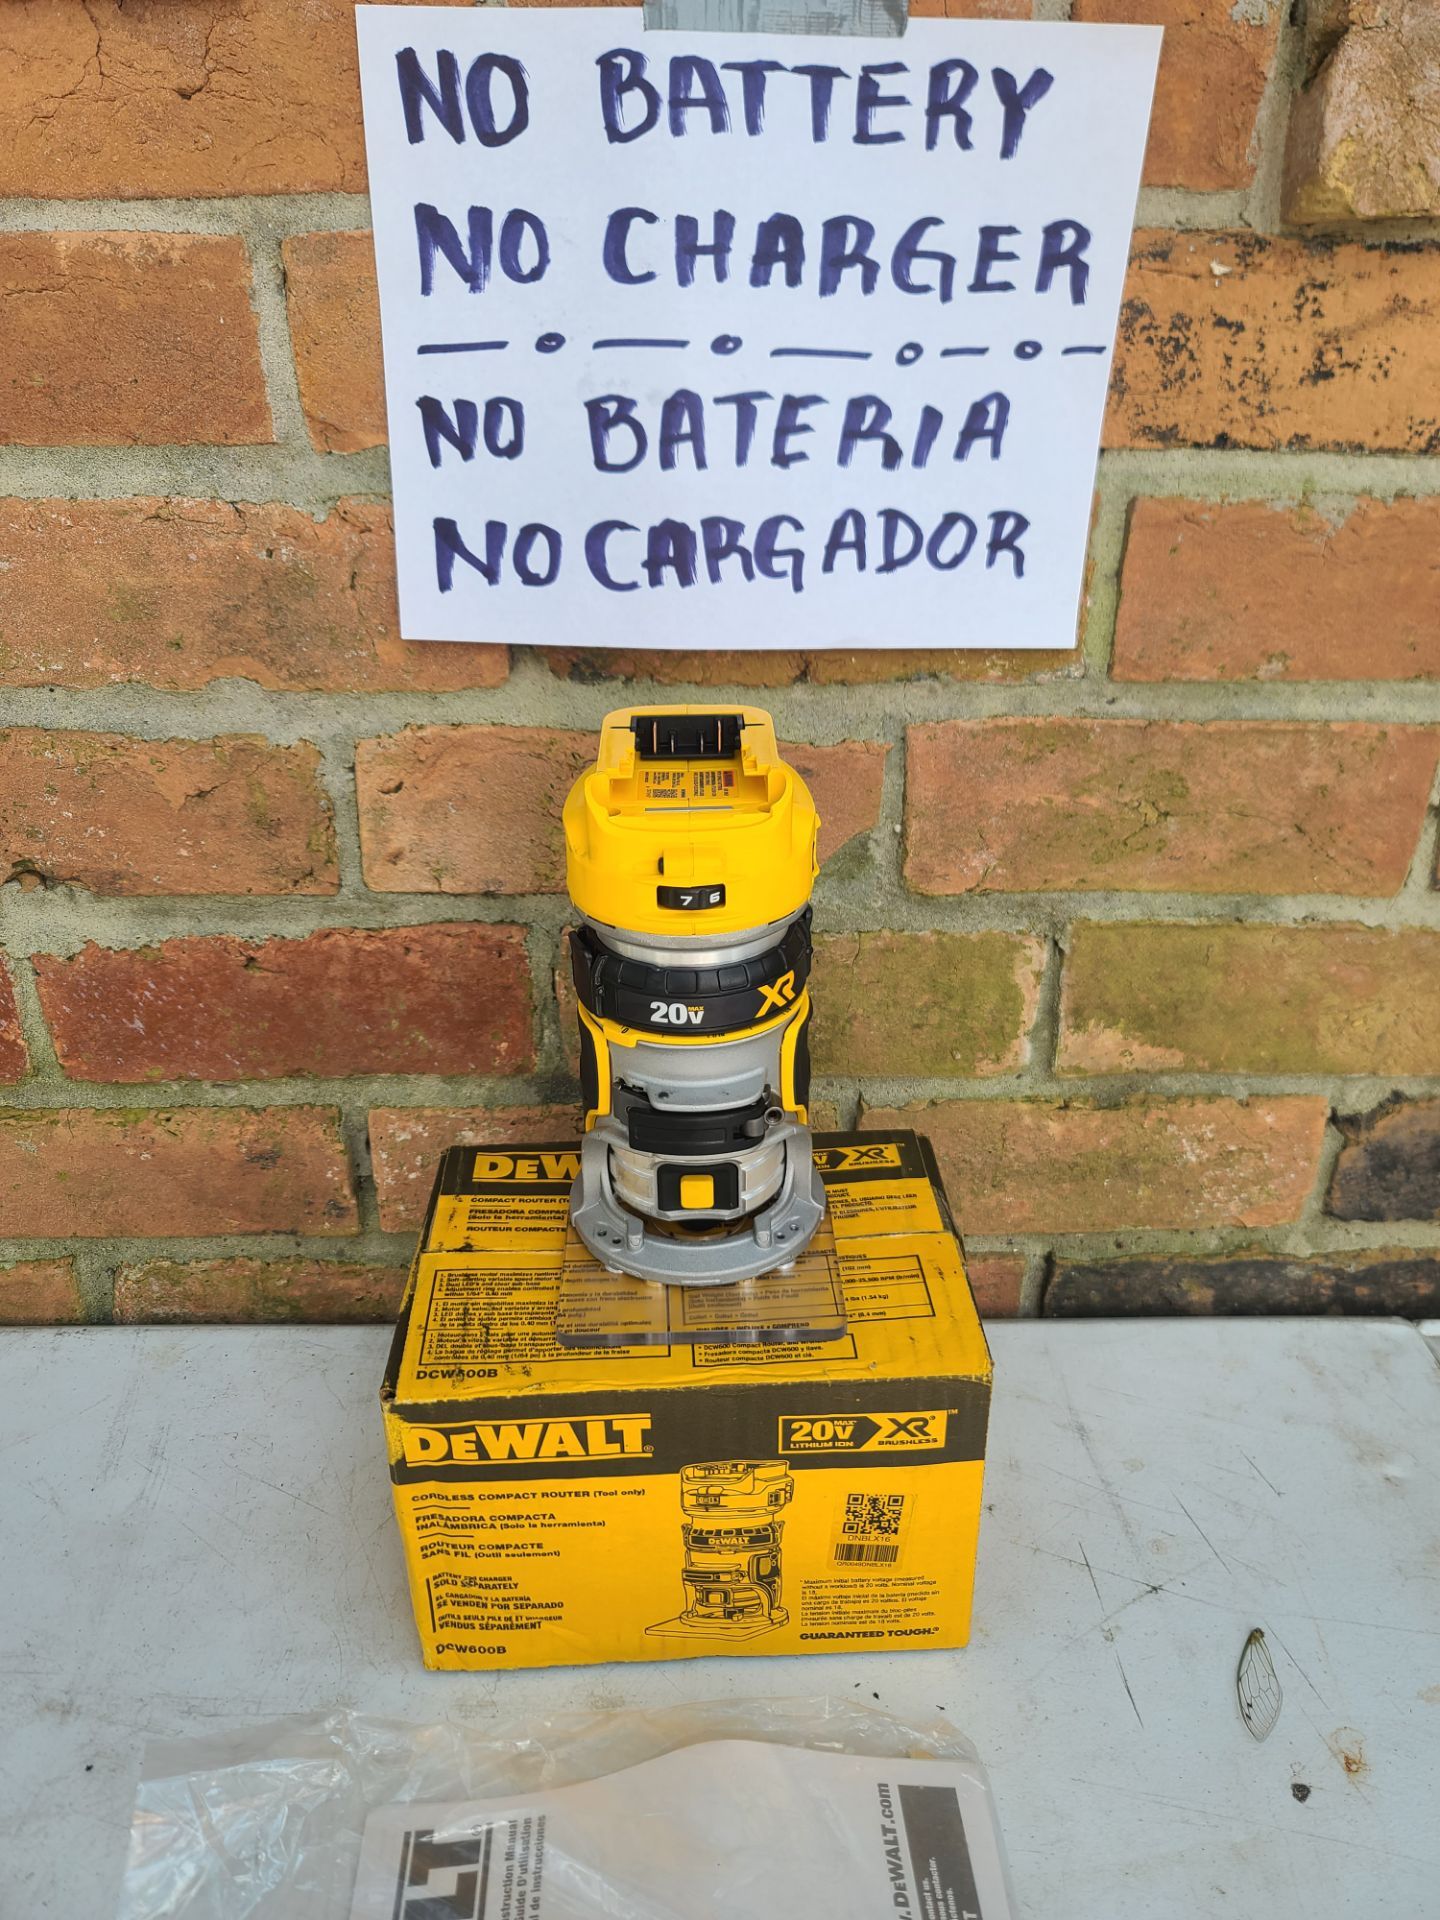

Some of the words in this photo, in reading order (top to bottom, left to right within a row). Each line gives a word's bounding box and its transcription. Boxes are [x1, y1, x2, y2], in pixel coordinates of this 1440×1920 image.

[395, 47, 530, 147] NO
[596, 48, 1054, 159] BATTERY
[414, 202, 549, 296] NO
[602, 208, 1091, 305] CHARGER
[417, 396, 524, 468] NO
[587, 390, 1010, 472] BATERIA
[433, 518, 561, 593] NO
[585, 508, 1031, 593] CARGADOR
[680, 896, 692, 905] 7
[709, 892, 720, 904] 6
[755, 970, 796, 1018] XR
[852, 1148, 888, 1160] XR
[884, 1416, 932, 1438] XR
[403, 1419, 651, 1462] DEWALT
[878, 1438, 938, 1446] BRUSHLESS
[412, 1492, 475, 1502] CORDLESS
[479, 1492, 537, 1501] COMPACT
[621, 1488, 646, 1497] only)
[415, 1513, 485, 1523] FRESADORA
[489, 1513, 556, 1521] COMPACTA
[416, 1520, 497, 1531] INALÁMBRICA
[500, 1522, 525, 1530] (Solo
[541, 1520, 606, 1528] herramienta)
[420, 1541, 475, 1552] ROUTEUR
[708, 1537, 750, 1545] DEWALT
[475, 1551, 502, 1559] (Outil
[504, 1550, 561, 1558] seulement)
[433, 1580, 458, 1589] SOLD
[450, 1600, 488, 1609] VENDEN
[513, 1601, 564, 1610] SEPARADO
[439, 1622, 476, 1630] VENDUS
[800, 1631, 885, 1639] GUARANTEED
[532, 1815, 546, 1893] instrucciones
